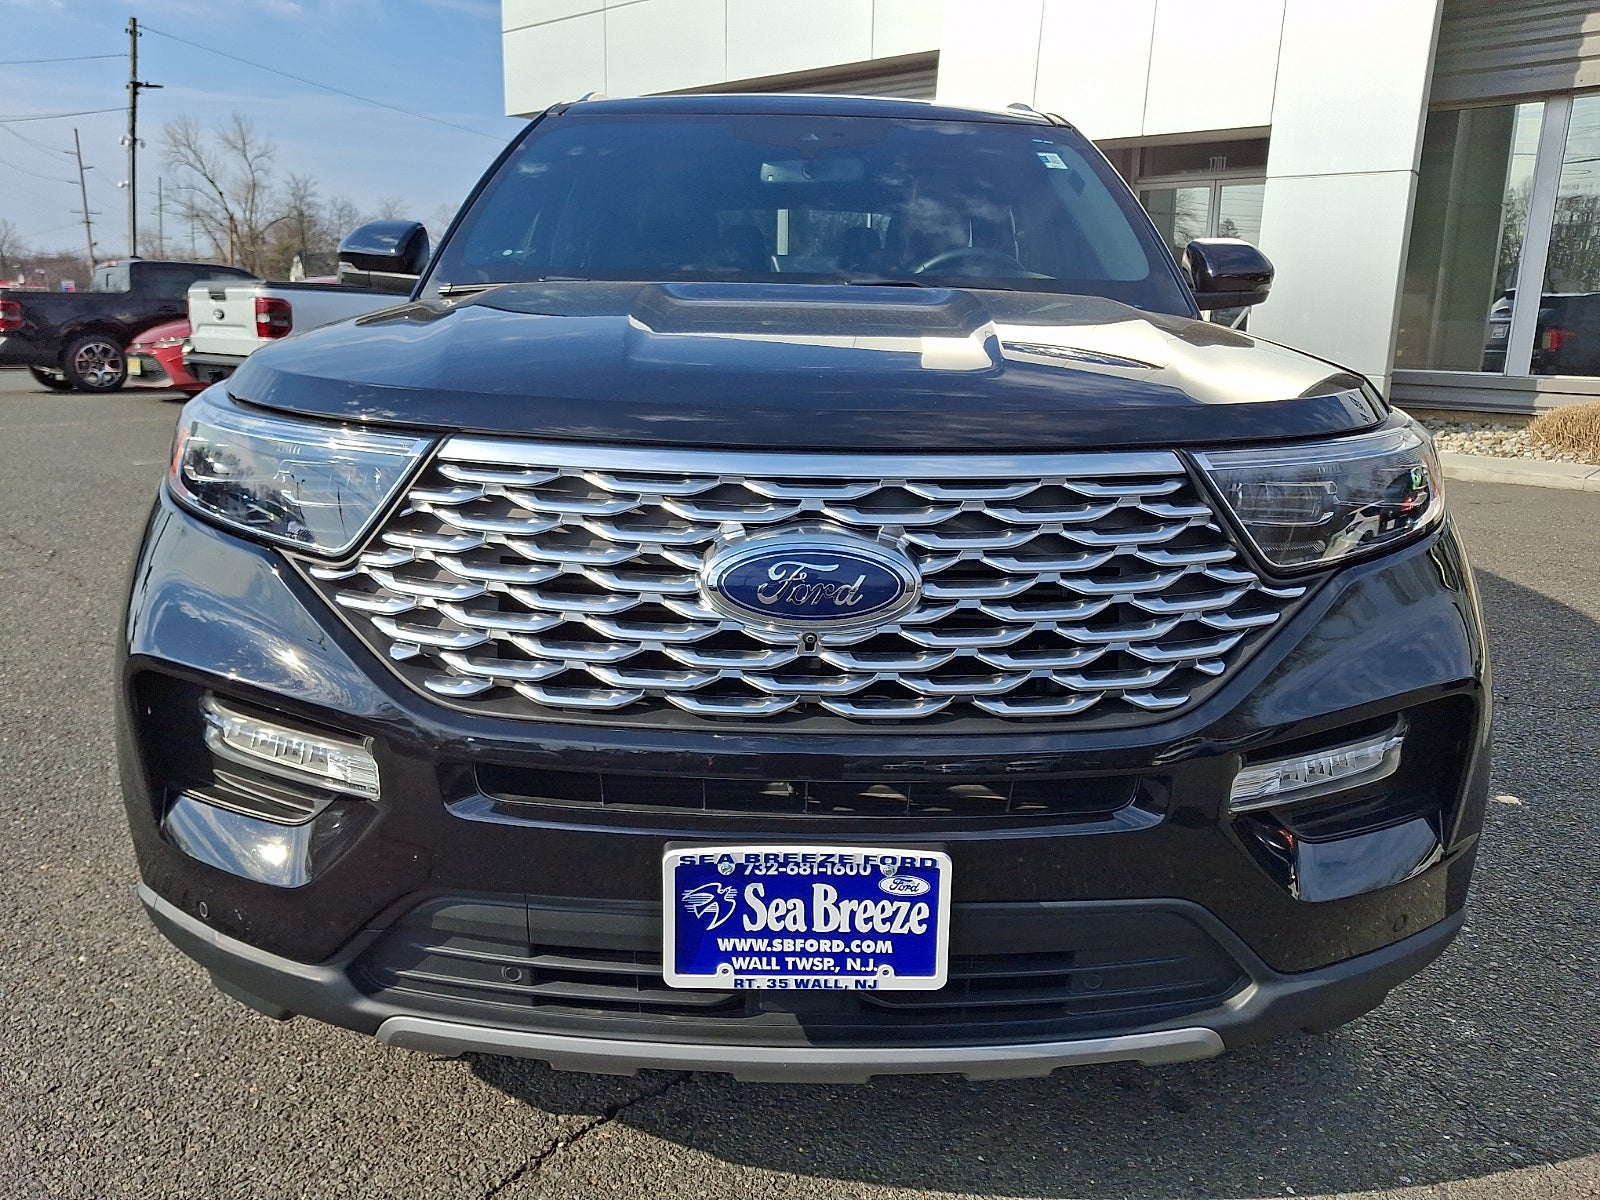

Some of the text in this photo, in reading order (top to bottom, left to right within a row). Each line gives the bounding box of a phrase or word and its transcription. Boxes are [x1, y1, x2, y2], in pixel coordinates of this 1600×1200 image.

[757, 560, 867, 606] Ford
[679, 852, 938, 868] SEA BREEZE FORD
[743, 862, 872, 876] 732-681-1600
[889, 878, 921, 893] Ford
[743, 883, 930, 935] Sea Breeze
[717, 938, 893, 954] WWW.SBFORD.COM
[731, 956, 878, 973] WALL TWSP., N.J.
[733, 978, 880, 990] RT. 35 WALL, NJ
